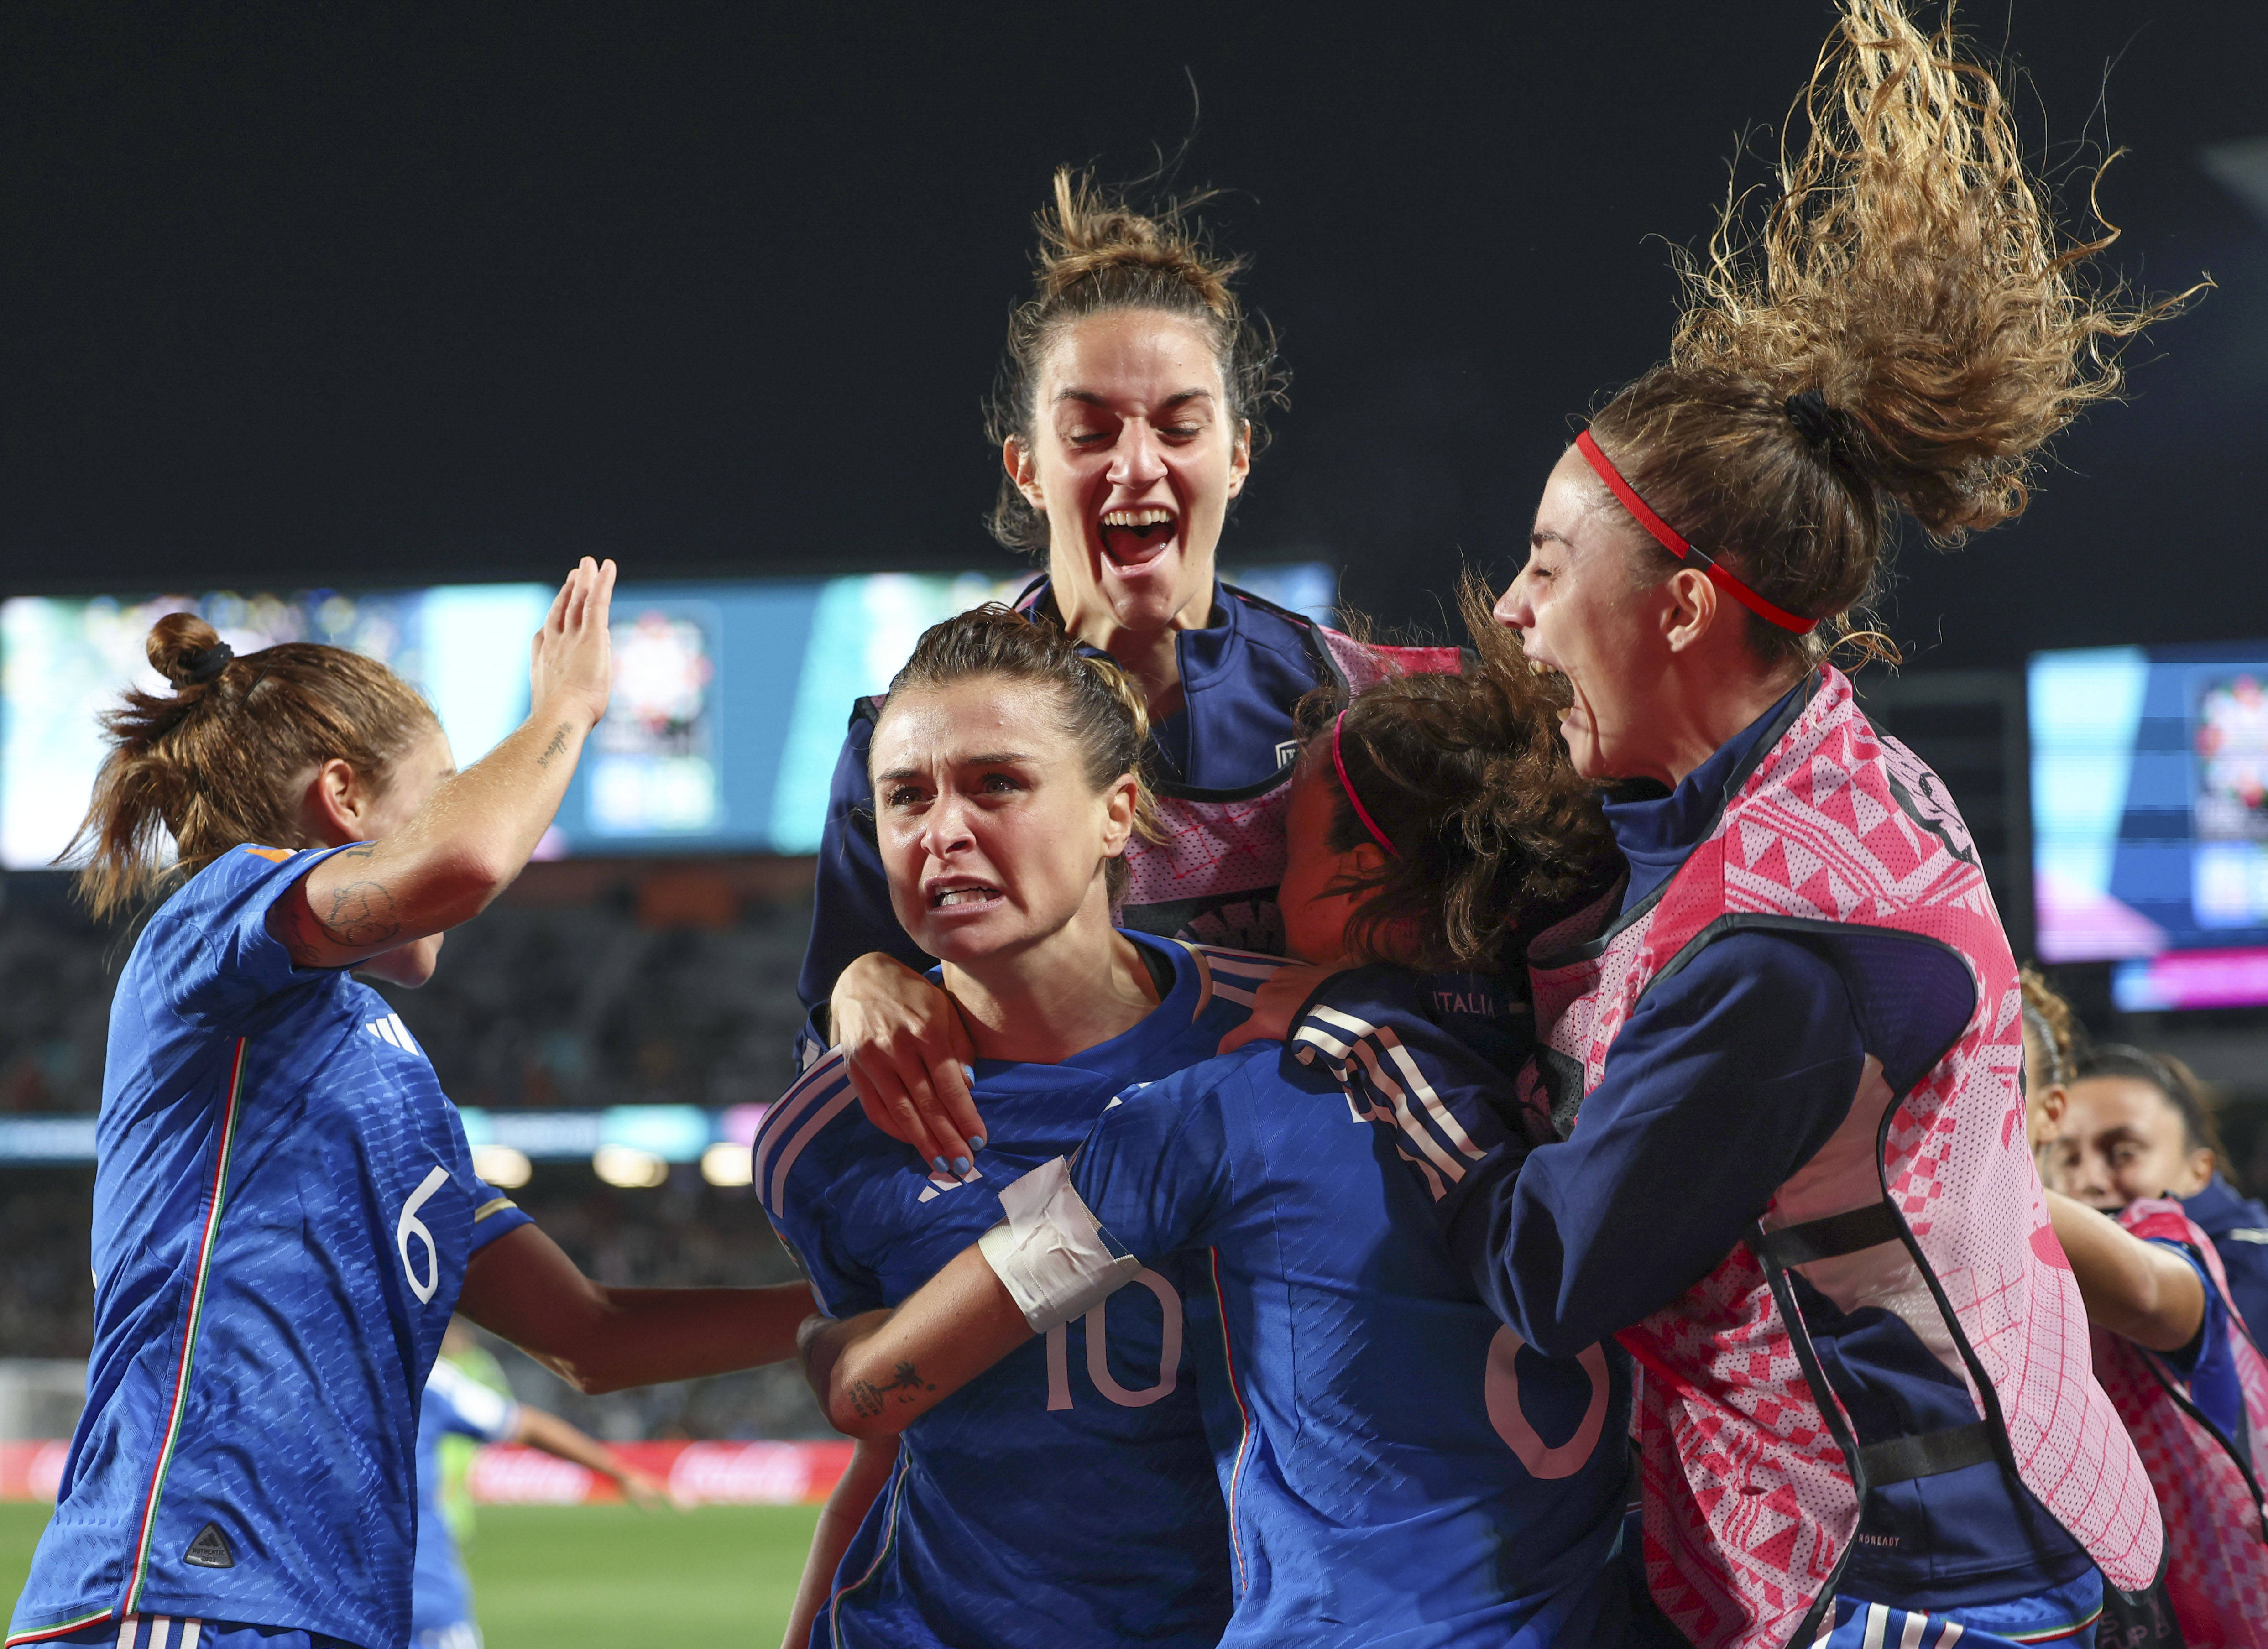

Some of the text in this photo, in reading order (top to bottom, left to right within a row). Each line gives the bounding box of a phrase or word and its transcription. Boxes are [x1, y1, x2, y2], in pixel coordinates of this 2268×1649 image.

[1433, 991, 1495, 1018] ITALIA
[397, 1165, 450, 1305] 6
[1046, 1267, 1182, 1411] 10
[192, 1548, 225, 1556] AUTHENTIC
